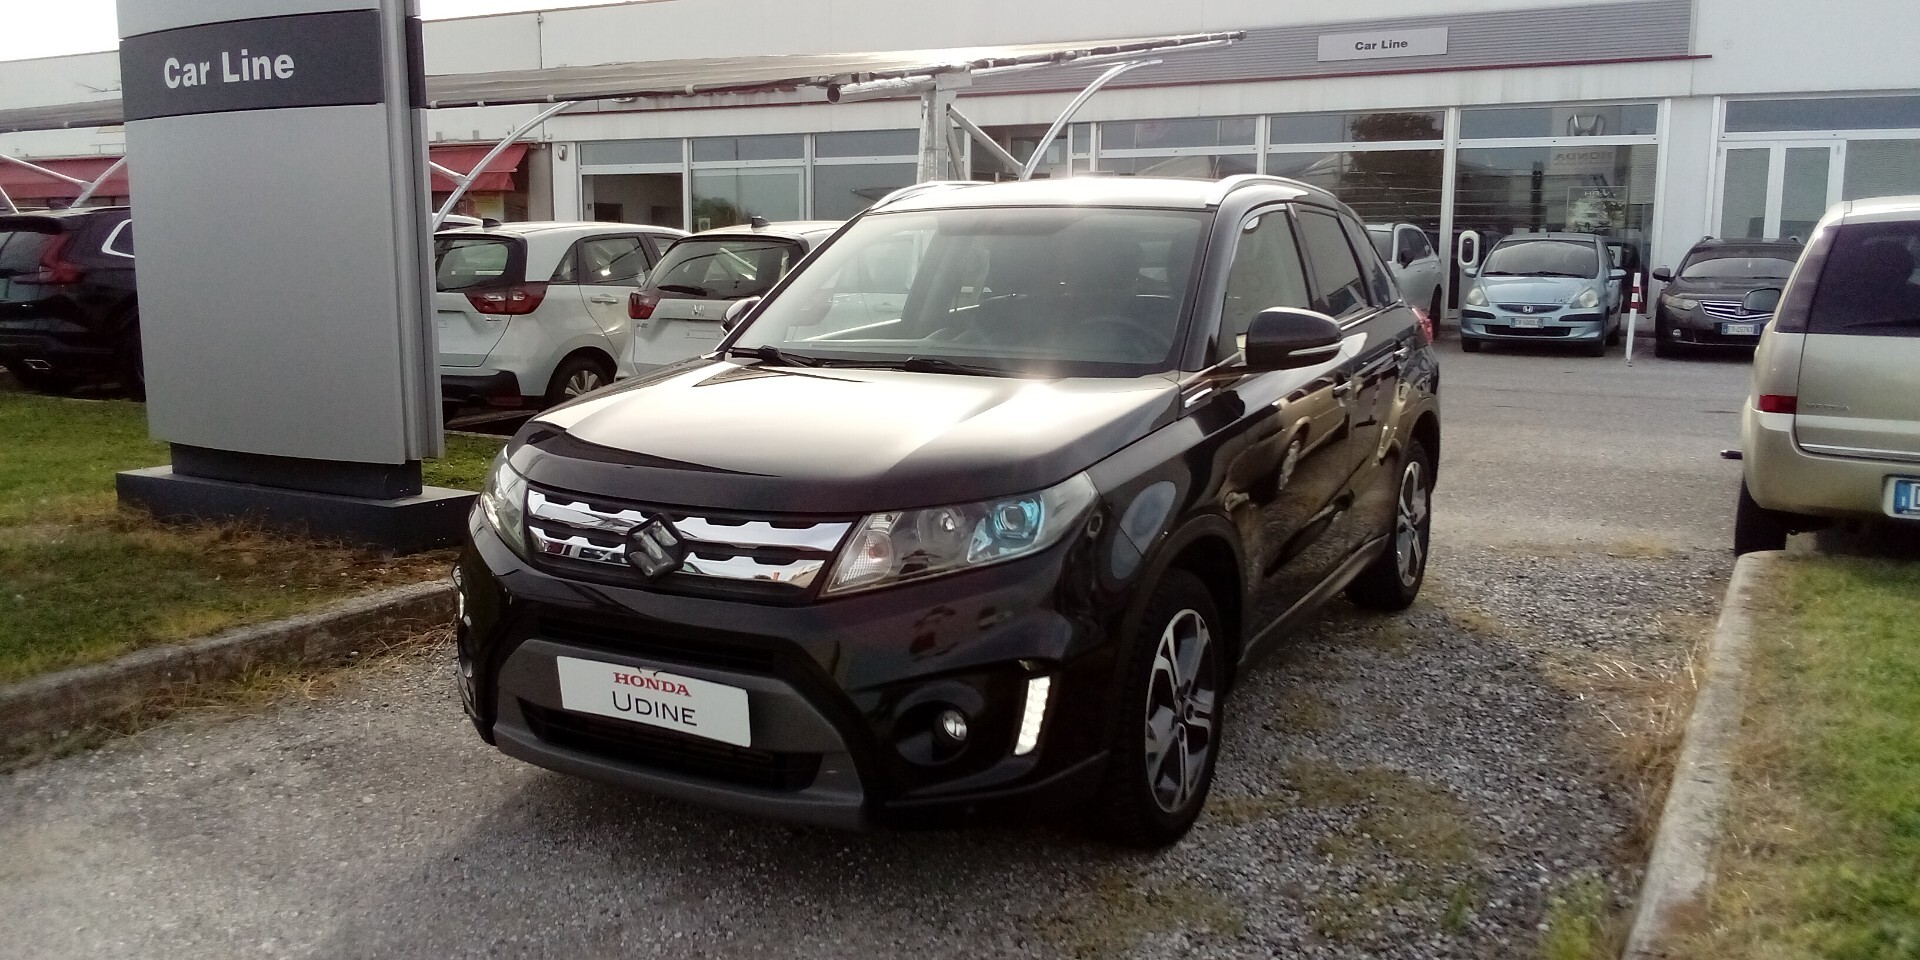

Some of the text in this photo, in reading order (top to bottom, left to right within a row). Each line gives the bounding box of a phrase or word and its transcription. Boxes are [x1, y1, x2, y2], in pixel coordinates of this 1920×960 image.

[1355, 40, 1408, 50] Car Line
[164, 48, 295, 89] Car Line
[613, 672, 692, 698] HONDA
[612, 690, 698, 727] UDINE
